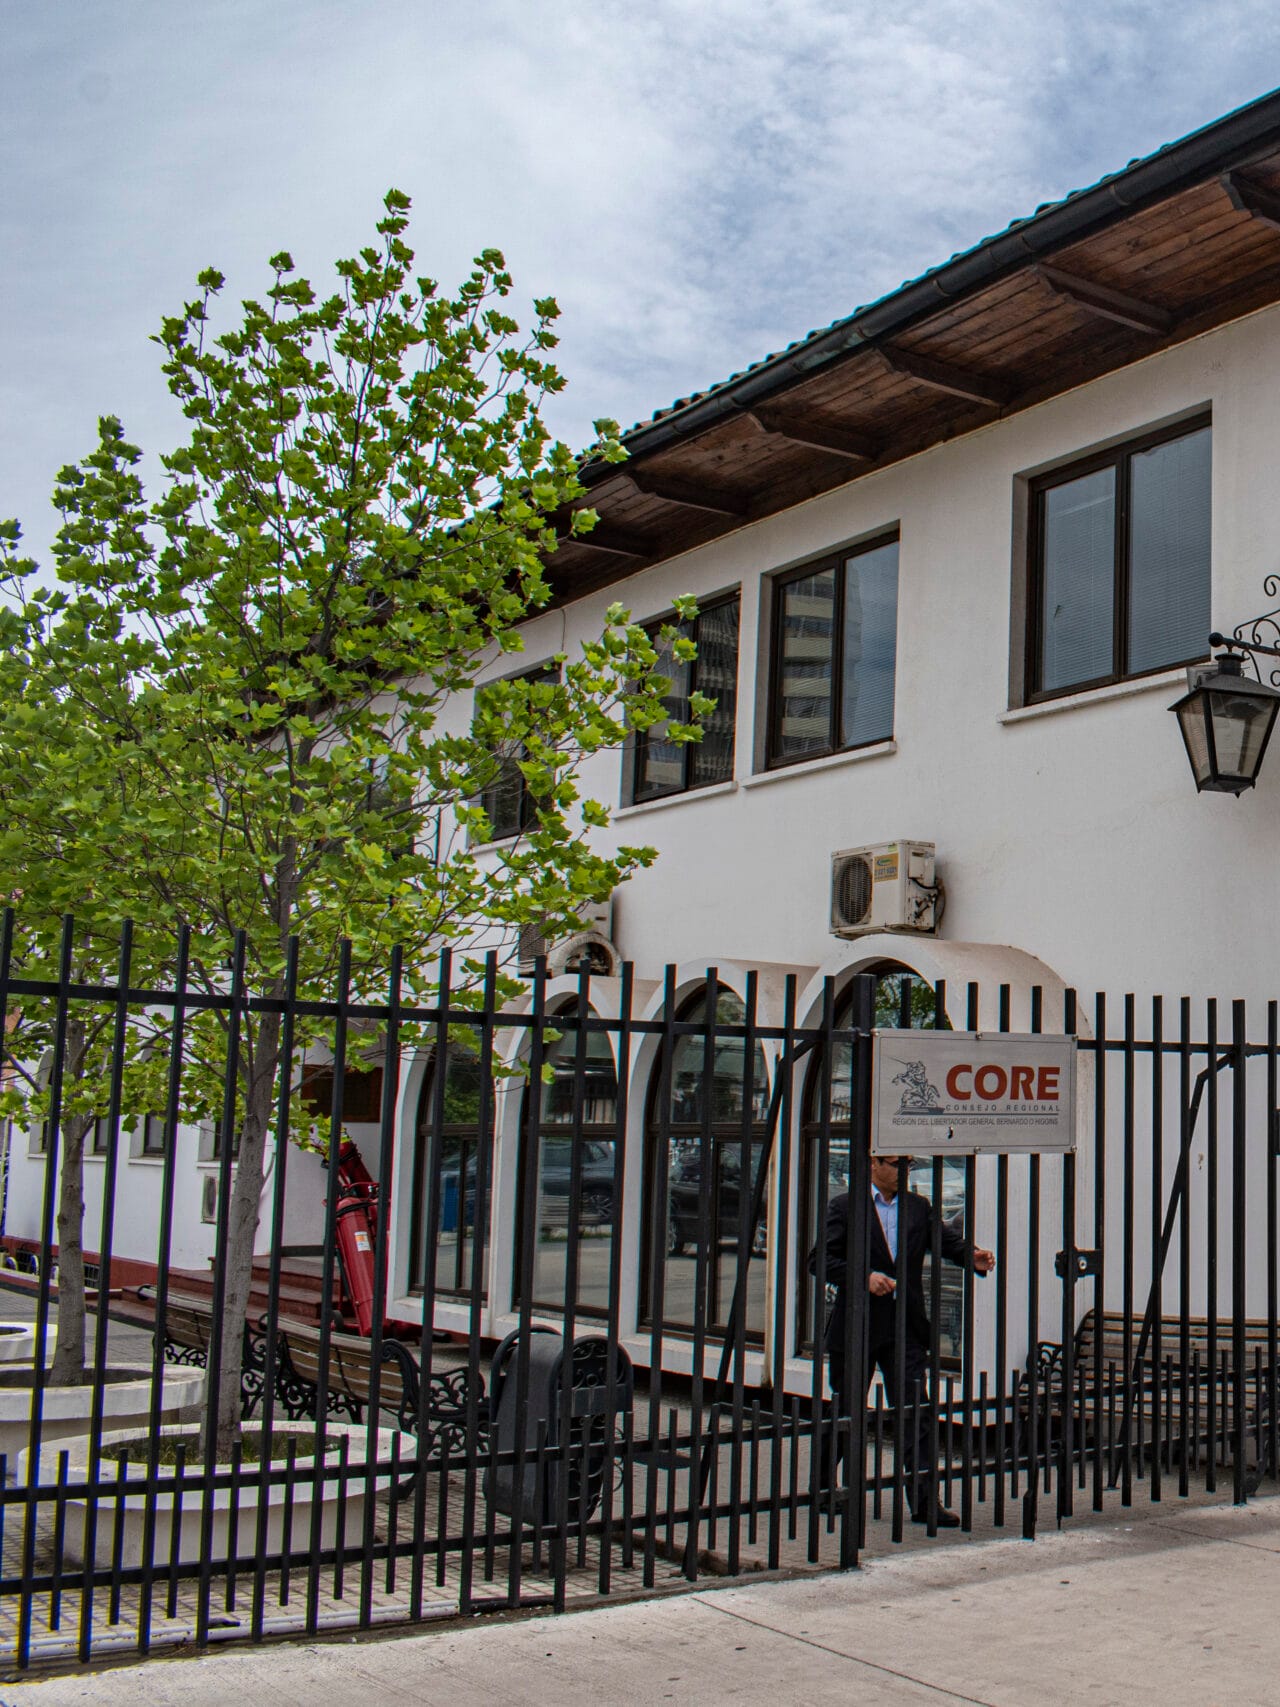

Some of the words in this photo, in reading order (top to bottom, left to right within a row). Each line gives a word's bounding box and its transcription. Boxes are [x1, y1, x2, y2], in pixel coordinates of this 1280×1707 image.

[946, 1064, 1061, 1101] CORE
[945, 1104, 997, 1112] CONSEJO
[1006, 1104, 1060, 1112] REGIONAL
[917, 1118, 929, 1126] DEL
[931, 1118, 968, 1126] LIBERTADOR
[968, 1118, 995, 1126] GENERAL
[996, 1118, 1028, 1126] BERNARDO
